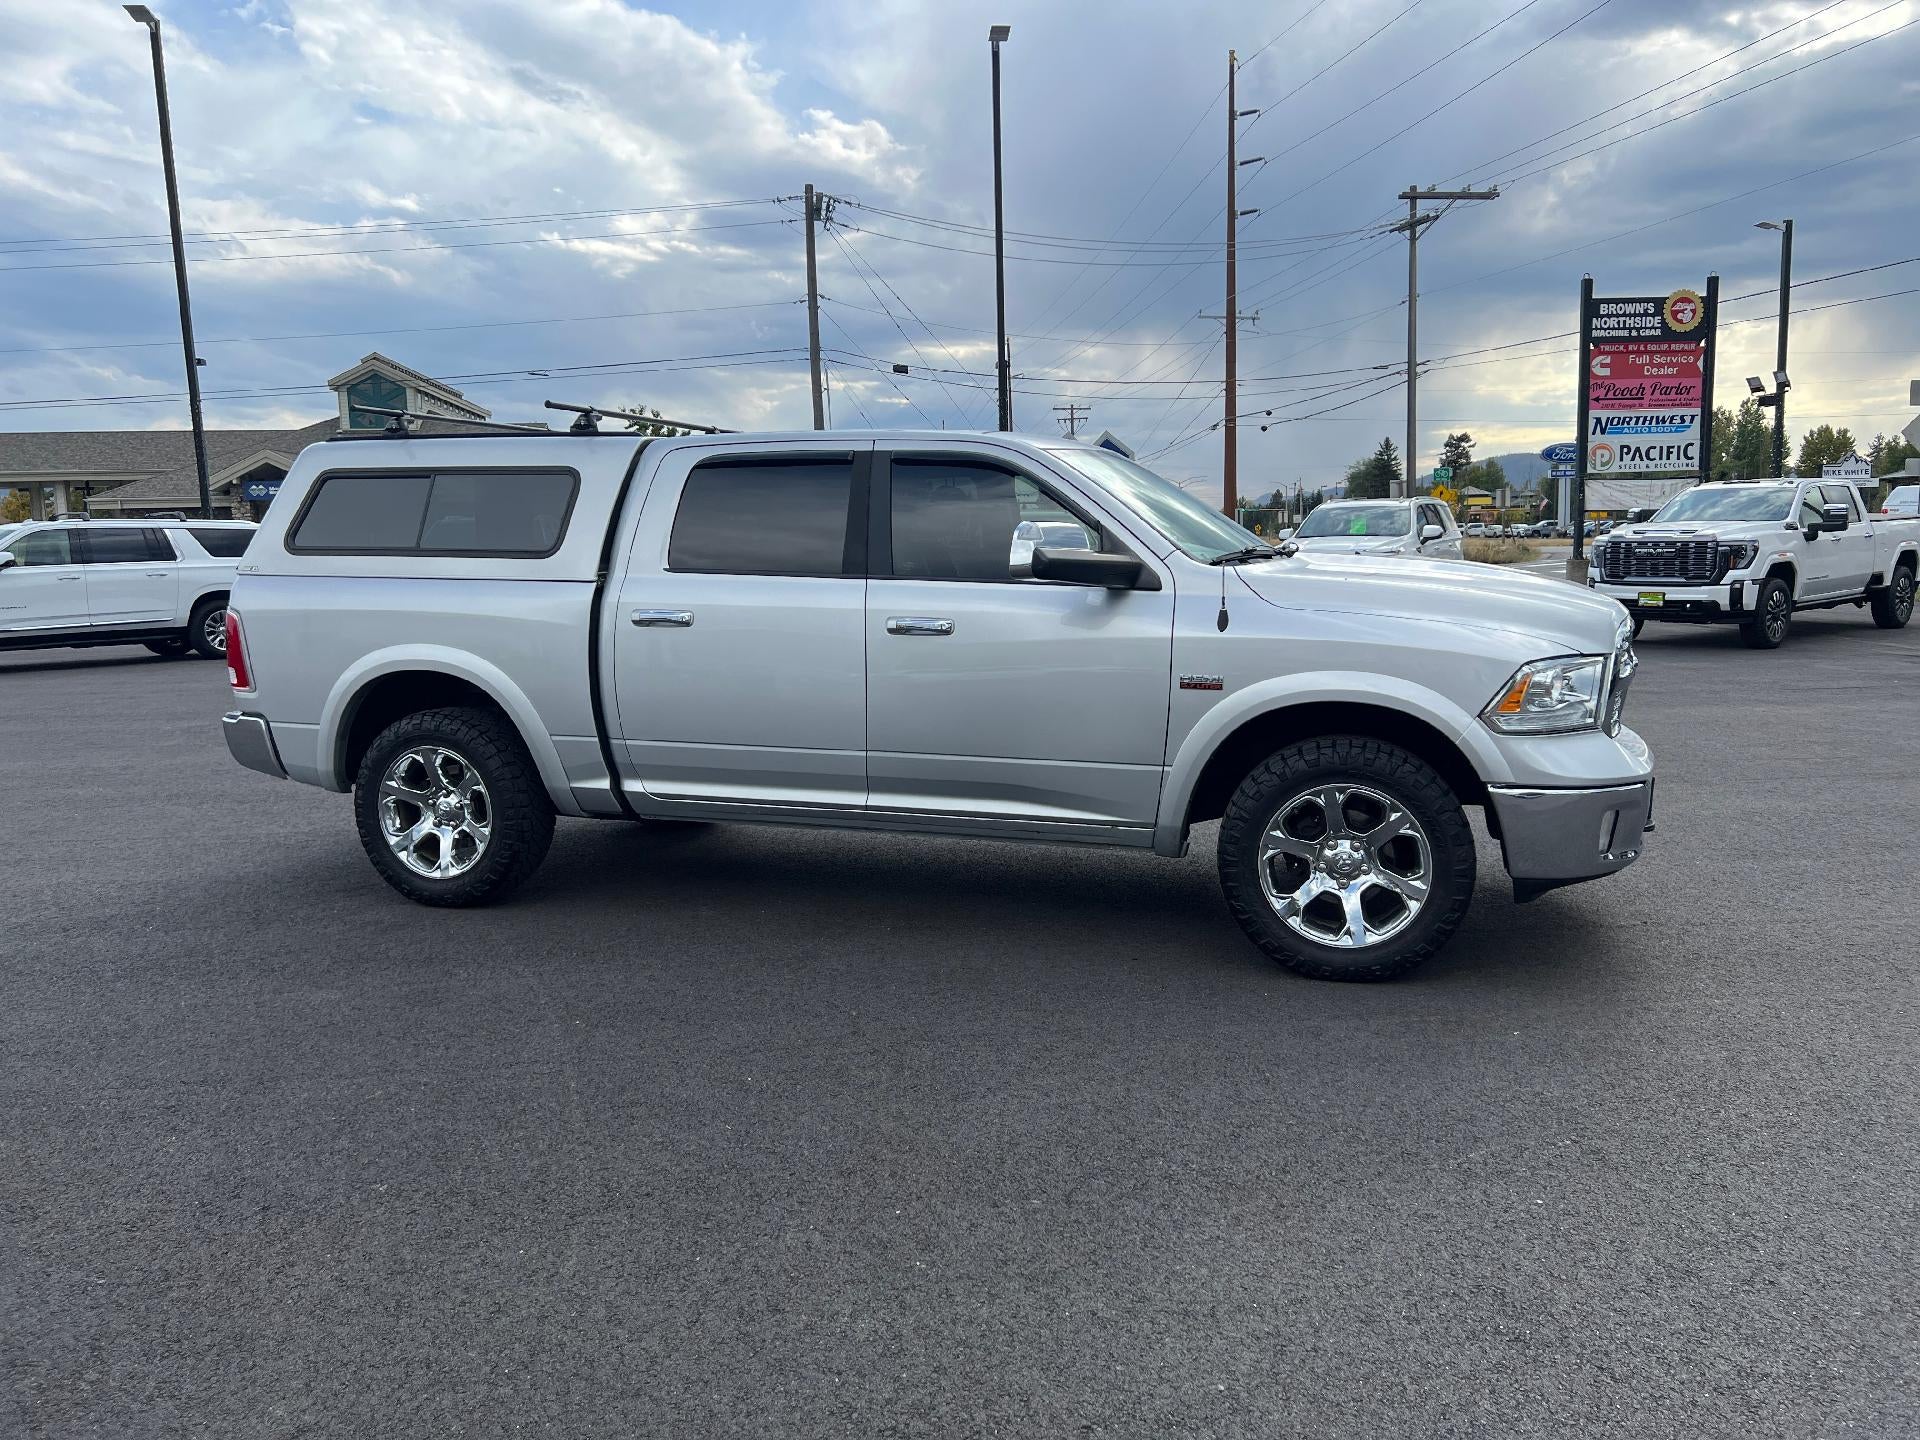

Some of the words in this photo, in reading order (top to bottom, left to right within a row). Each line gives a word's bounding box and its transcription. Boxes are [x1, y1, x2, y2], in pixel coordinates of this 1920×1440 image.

[1599, 302, 1655, 315] BROWN'S
[1591, 316, 1662, 329] NORTHSIDE
[1591, 329, 1630, 337] MACHINE
[1630, 329, 1638, 337] &
[1639, 328, 1662, 336] GEAR
[1628, 354, 1650, 365] Full
[1652, 354, 1695, 363] Service
[1643, 365, 1679, 375] Dealer
[1590, 380, 1605, 393] The
[1603, 382, 1646, 398] Pooch
[1649, 381, 1696, 397] Parlor
[1591, 414, 1699, 436] NORTHWEST
[1622, 426, 1650, 434] AUTO
[1619, 442, 1696, 462] PACIFIC
[1843, 468, 1870, 476] WHITE
